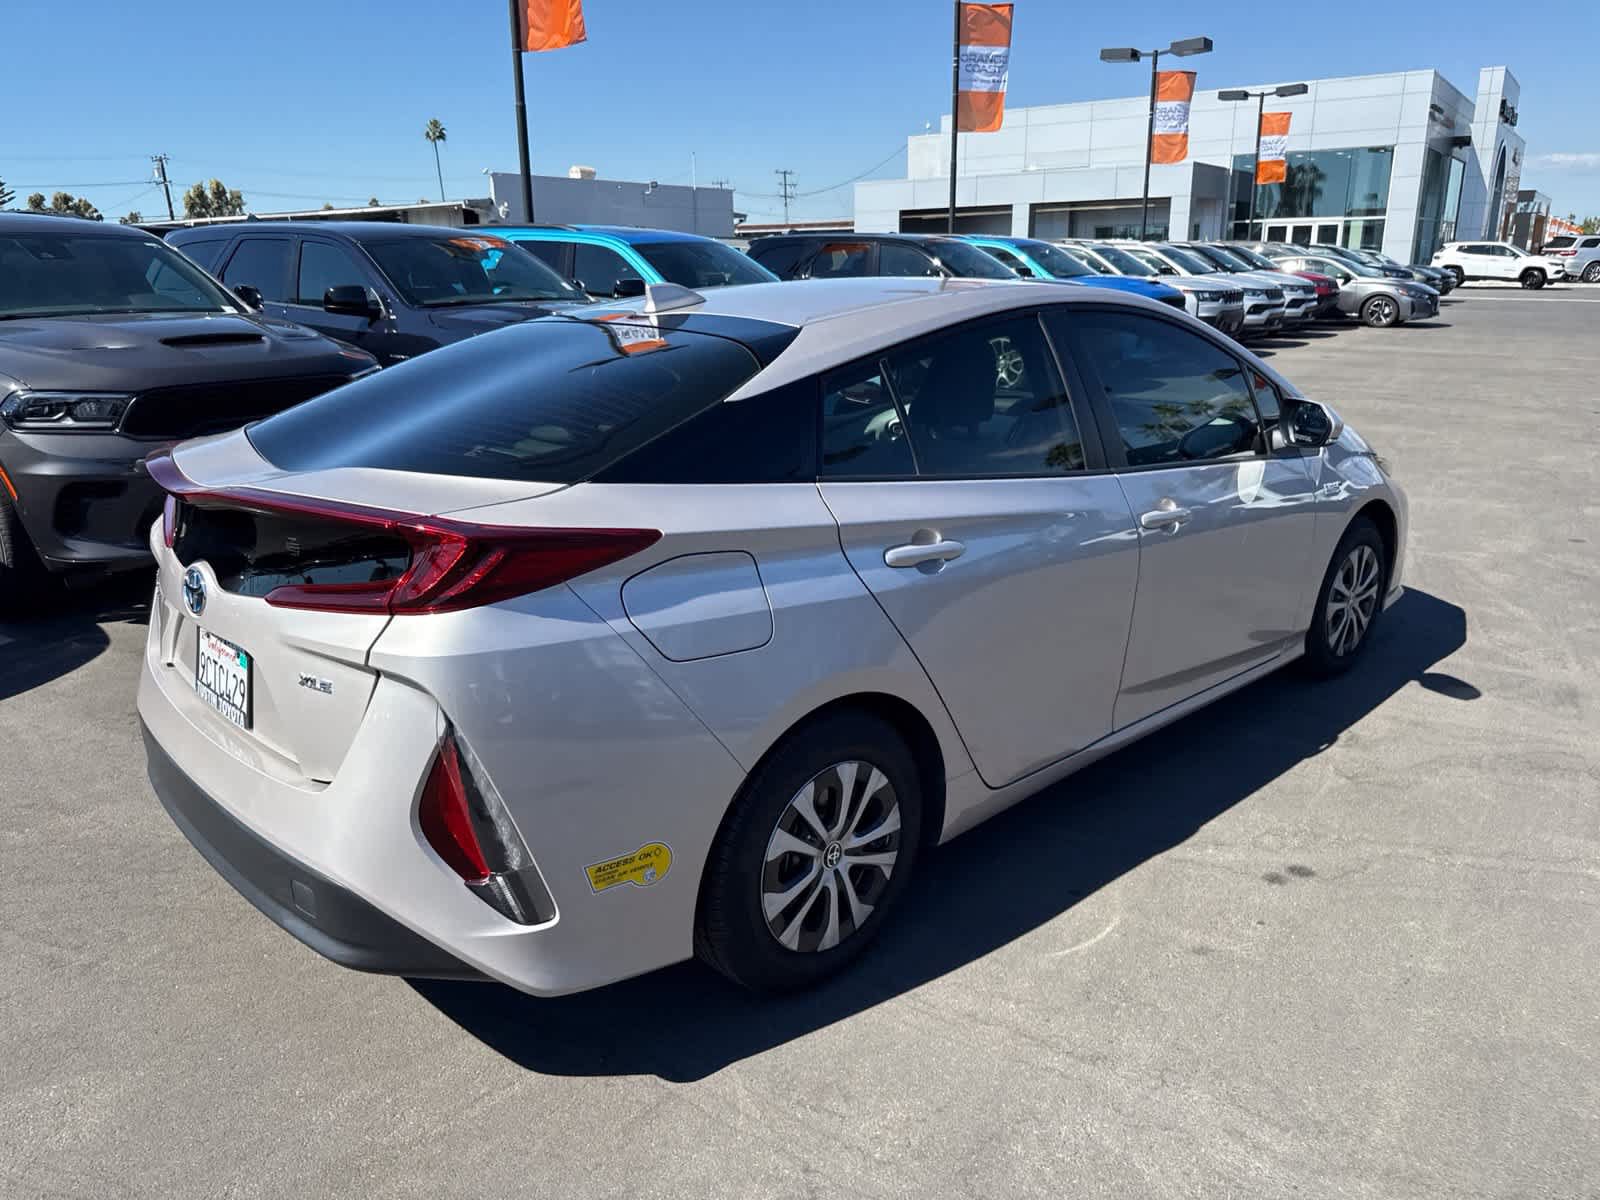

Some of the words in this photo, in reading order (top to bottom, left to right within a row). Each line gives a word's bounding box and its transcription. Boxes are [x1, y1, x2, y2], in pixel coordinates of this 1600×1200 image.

[965, 63, 1003, 73] COAST
[201, 651, 246, 711] 9CTC429
[595, 855, 636, 873] ACCESS
[638, 850, 654, 861] OK
